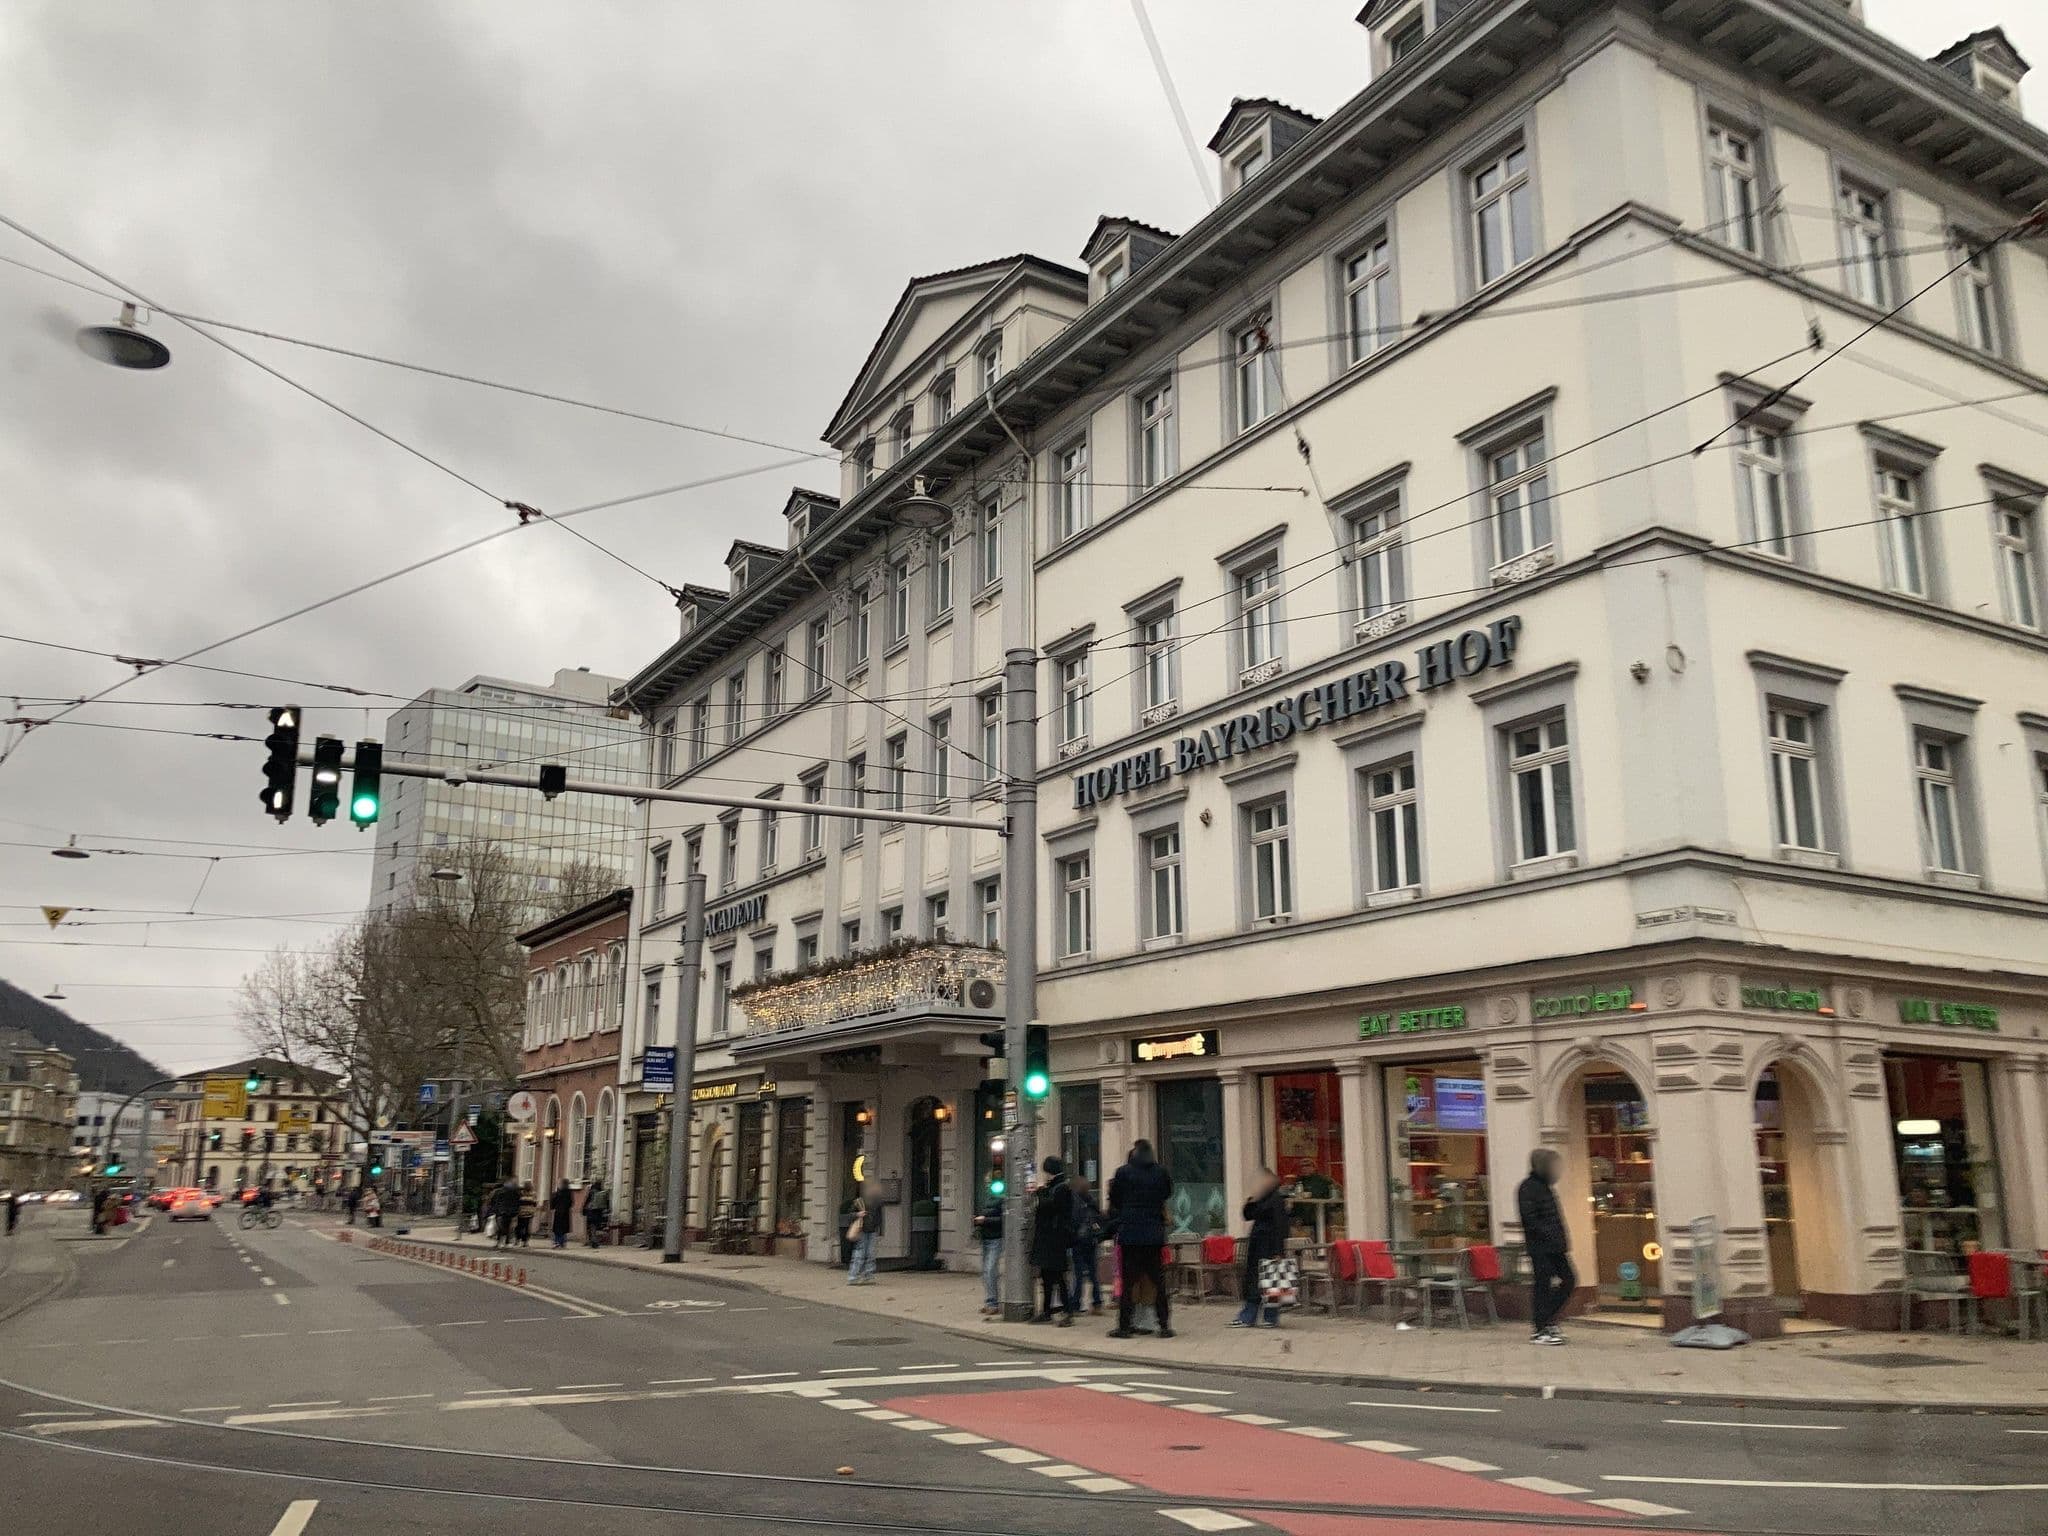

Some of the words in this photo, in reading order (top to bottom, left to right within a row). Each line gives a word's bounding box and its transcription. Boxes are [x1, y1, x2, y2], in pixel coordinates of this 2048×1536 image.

[1072, 747, 1170, 809] HOTEL
[1173, 660, 1409, 775] BAYRISCHER
[1415, 614, 1522, 692] HOF
[704, 894, 768, 937] ACADEMY
[1359, 1013, 1391, 1037] EAT
[1398, 1005, 1467, 1034] BETTER
